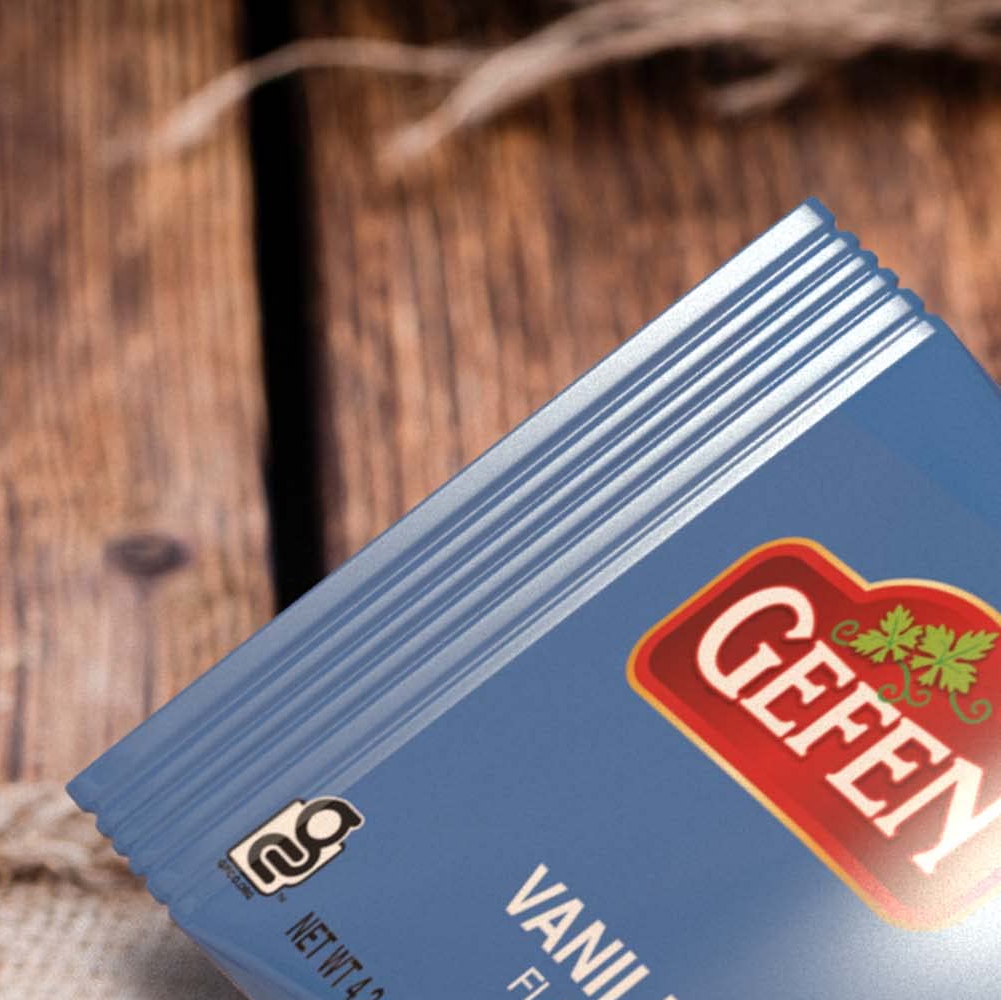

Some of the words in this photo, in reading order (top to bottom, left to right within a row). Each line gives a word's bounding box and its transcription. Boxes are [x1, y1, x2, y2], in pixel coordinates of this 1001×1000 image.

[696, 585, 1001, 875] GEFEN
[285, 911, 338, 959] NET
[317, 944, 364, 987] WT
